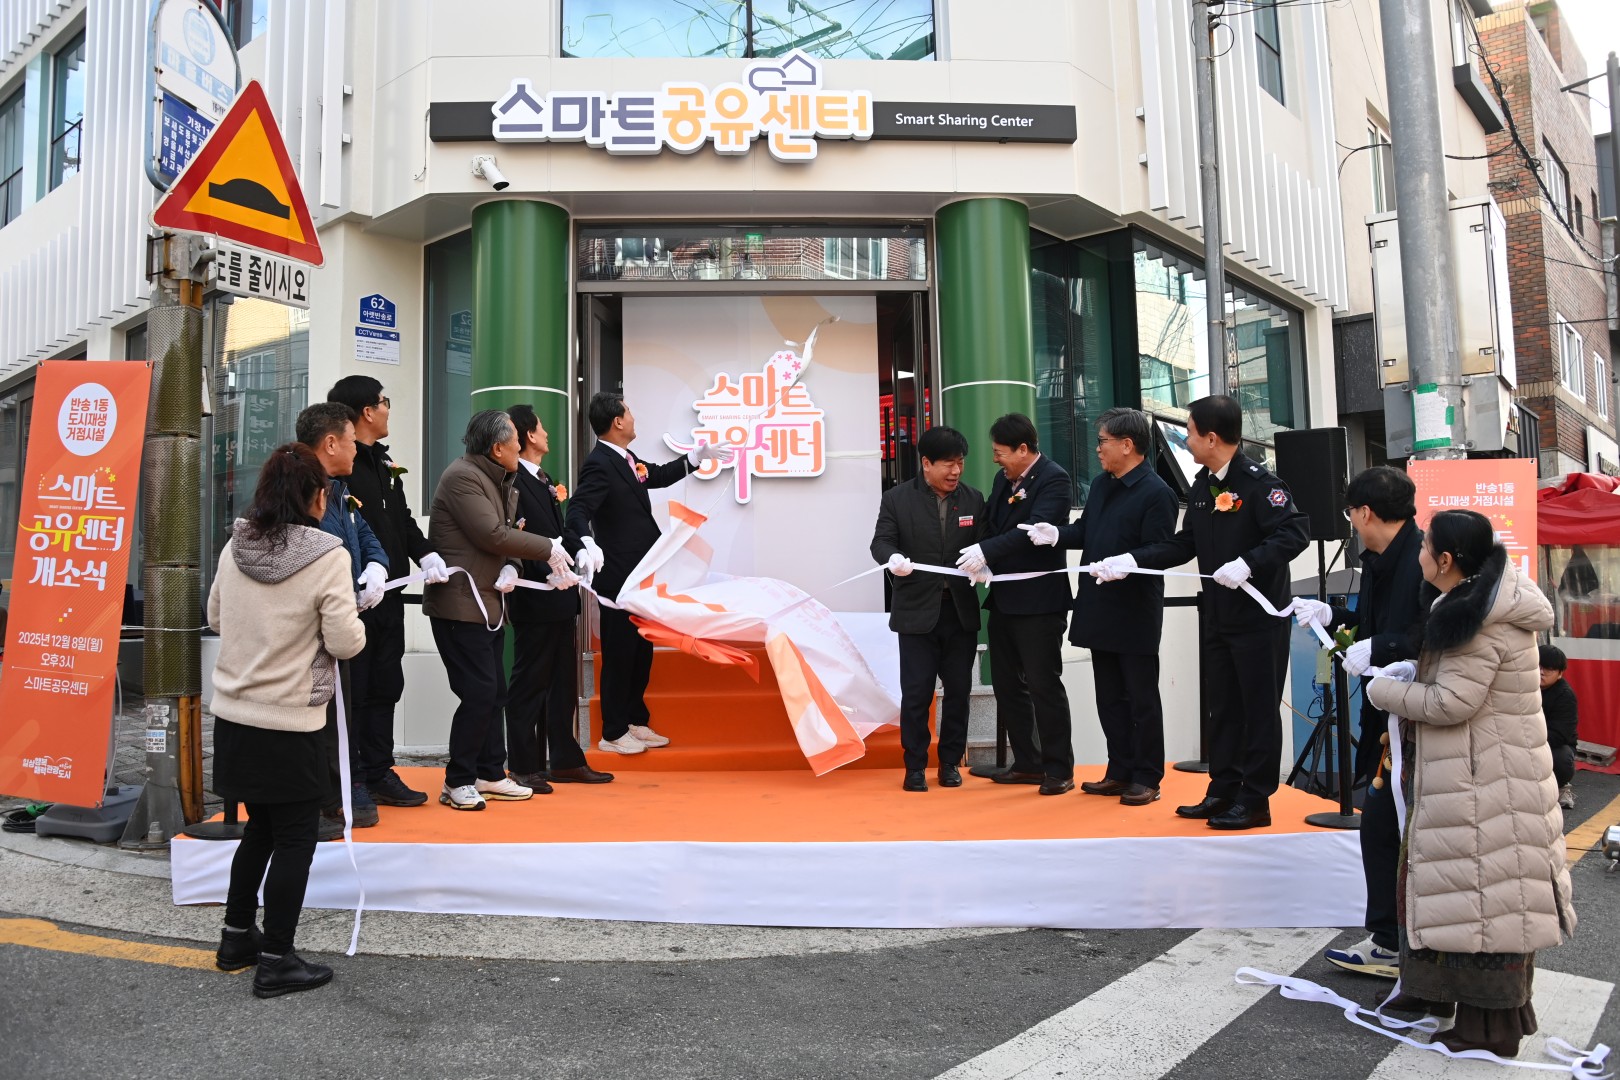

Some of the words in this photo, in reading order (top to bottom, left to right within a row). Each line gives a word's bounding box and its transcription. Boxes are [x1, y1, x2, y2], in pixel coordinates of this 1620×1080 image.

[895, 113, 935, 125] Smart
[938, 113, 987, 129] Sharing
[991, 115, 1034, 127] Center
[248, 255, 306, 301] 줄이시오
[370, 297, 385, 310] 62
[696, 365, 821, 419] 스마트
[71, 398, 91, 411] 반송
[94, 398, 109, 413] 1동
[67, 413, 107, 427] 도시재생
[65, 427, 105, 442] 거점시설
[38, 474, 125, 511] 스마트
[1428, 495, 1470, 507] 도시재생
[1472, 495, 1515, 507] 거점시설
[29, 512, 125, 552] 공유센터
[29, 556, 108, 592] 개소식
[18, 631, 50, 648] 2025년
[52, 634, 70, 649] 12월
[71, 636, 103, 653] 8일(월)
[40, 653, 75, 669] 오후3시
[23, 676, 89, 696] 스마트공유센터
